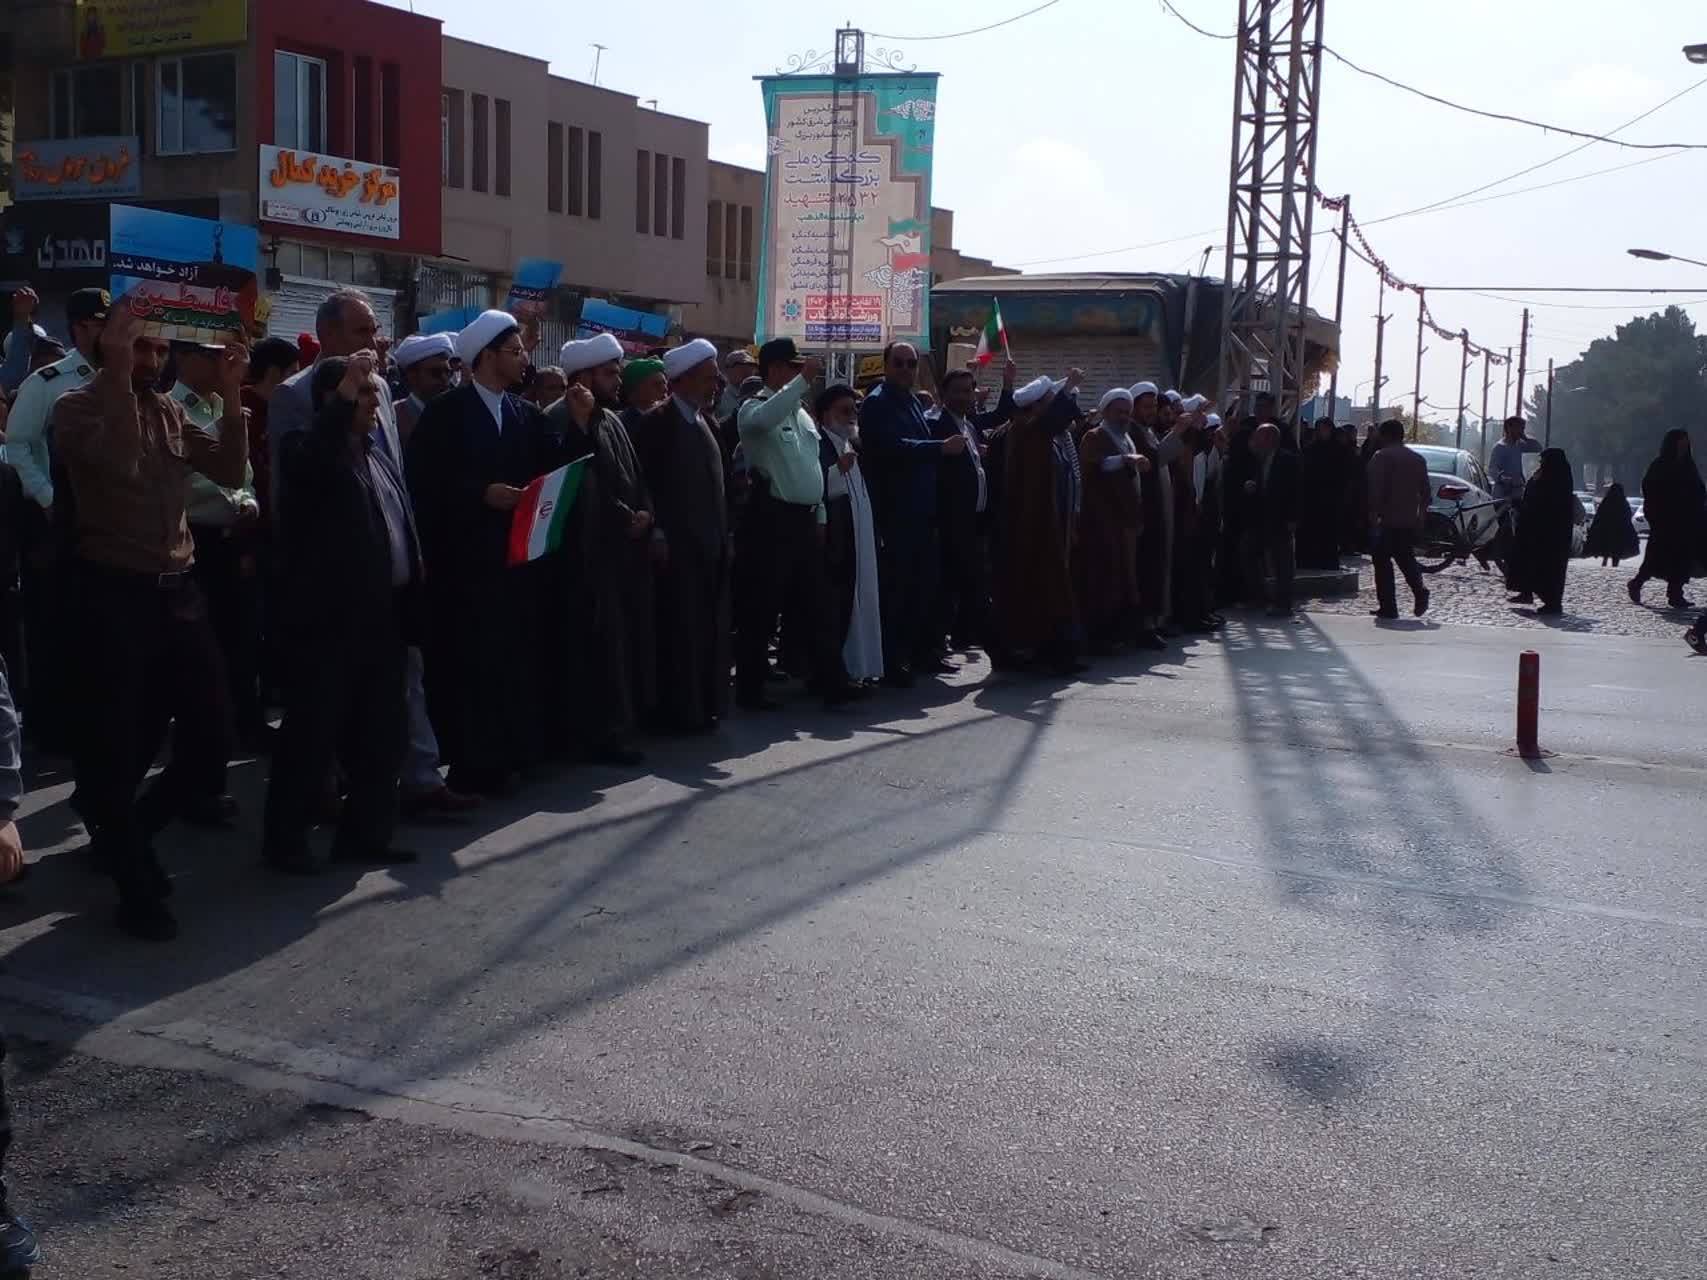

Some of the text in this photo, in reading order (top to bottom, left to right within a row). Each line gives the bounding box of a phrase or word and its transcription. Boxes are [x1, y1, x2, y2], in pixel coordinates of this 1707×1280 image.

[784, 150, 881, 168] کنگره ملی
[317, 162, 359, 198] خرید
[784, 168, 880, 187] بزرگداشت
[136, 261, 177, 278] خواهد
[178, 266, 200, 281] آزاد
[128, 281, 236, 318] فلسطین
